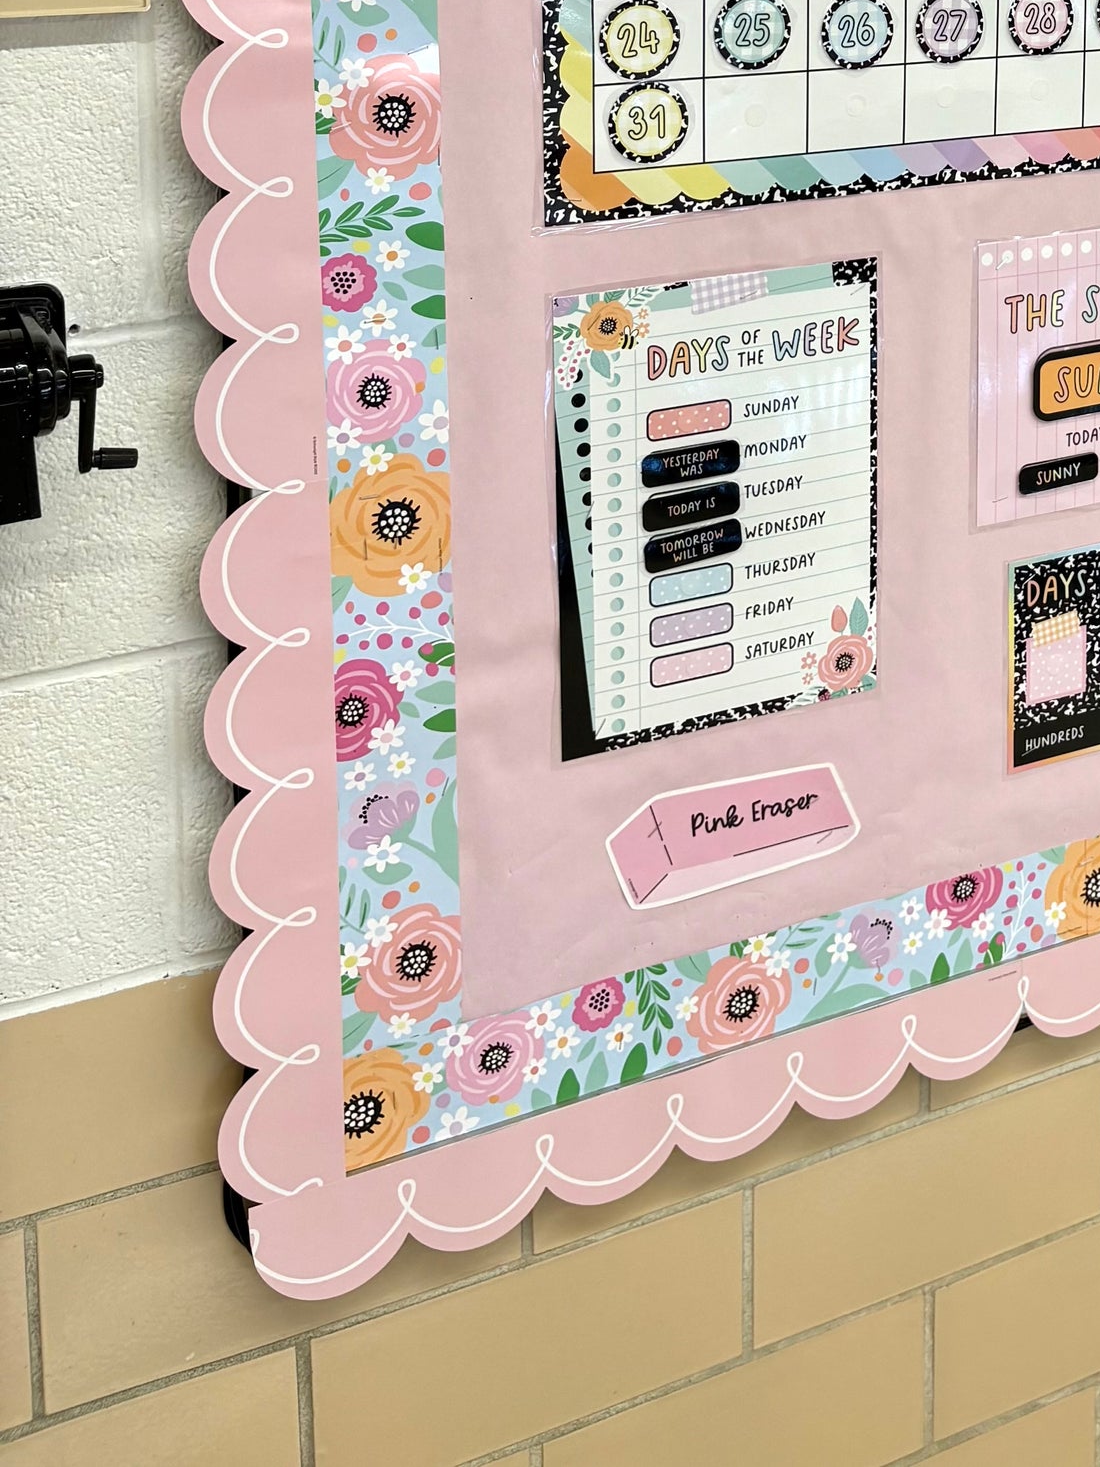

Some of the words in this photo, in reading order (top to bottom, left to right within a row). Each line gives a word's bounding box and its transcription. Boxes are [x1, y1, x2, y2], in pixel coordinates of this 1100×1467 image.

[617, 21, 660, 58] 24
[734, 13, 770, 47] 25
[838, 12, 875, 48] 26
[932, 9, 967, 42] 27
[1024, 3, 1057, 35] 28
[628, 104, 666, 141] 31
[1004, 289, 1064, 334] THE
[741, 329, 760, 345] OF
[772, 317, 860, 361] WEEK
[647, 335, 730, 381] DAYS
[738, 350, 764, 368] THE
[743, 395, 799, 417] SUNDAY
[662, 448, 720, 468] YESTERDAY
[744, 435, 807, 458] MONDAY
[680, 463, 703, 476] WAS
[1036, 462, 1081, 486] SUNNY
[744, 475, 803, 498] TUESDAY
[667, 500, 701, 518] TODAY
[706, 497, 716, 509] IS
[744, 511, 826, 539] WEDNESDAY
[660, 528, 724, 553] TOMORROW
[673, 547, 698, 563] WILL
[702, 543, 715, 554] BE
[744, 552, 816, 580] THURSDAY
[1027, 569, 1088, 607] DAYS
[745, 596, 794, 620] FRIDAY
[744, 631, 815, 659] SATURDAY
[1025, 725, 1085, 752] HUNDREDS
[691, 804, 744, 837] Pink
[752, 792, 819, 822] Eraser
